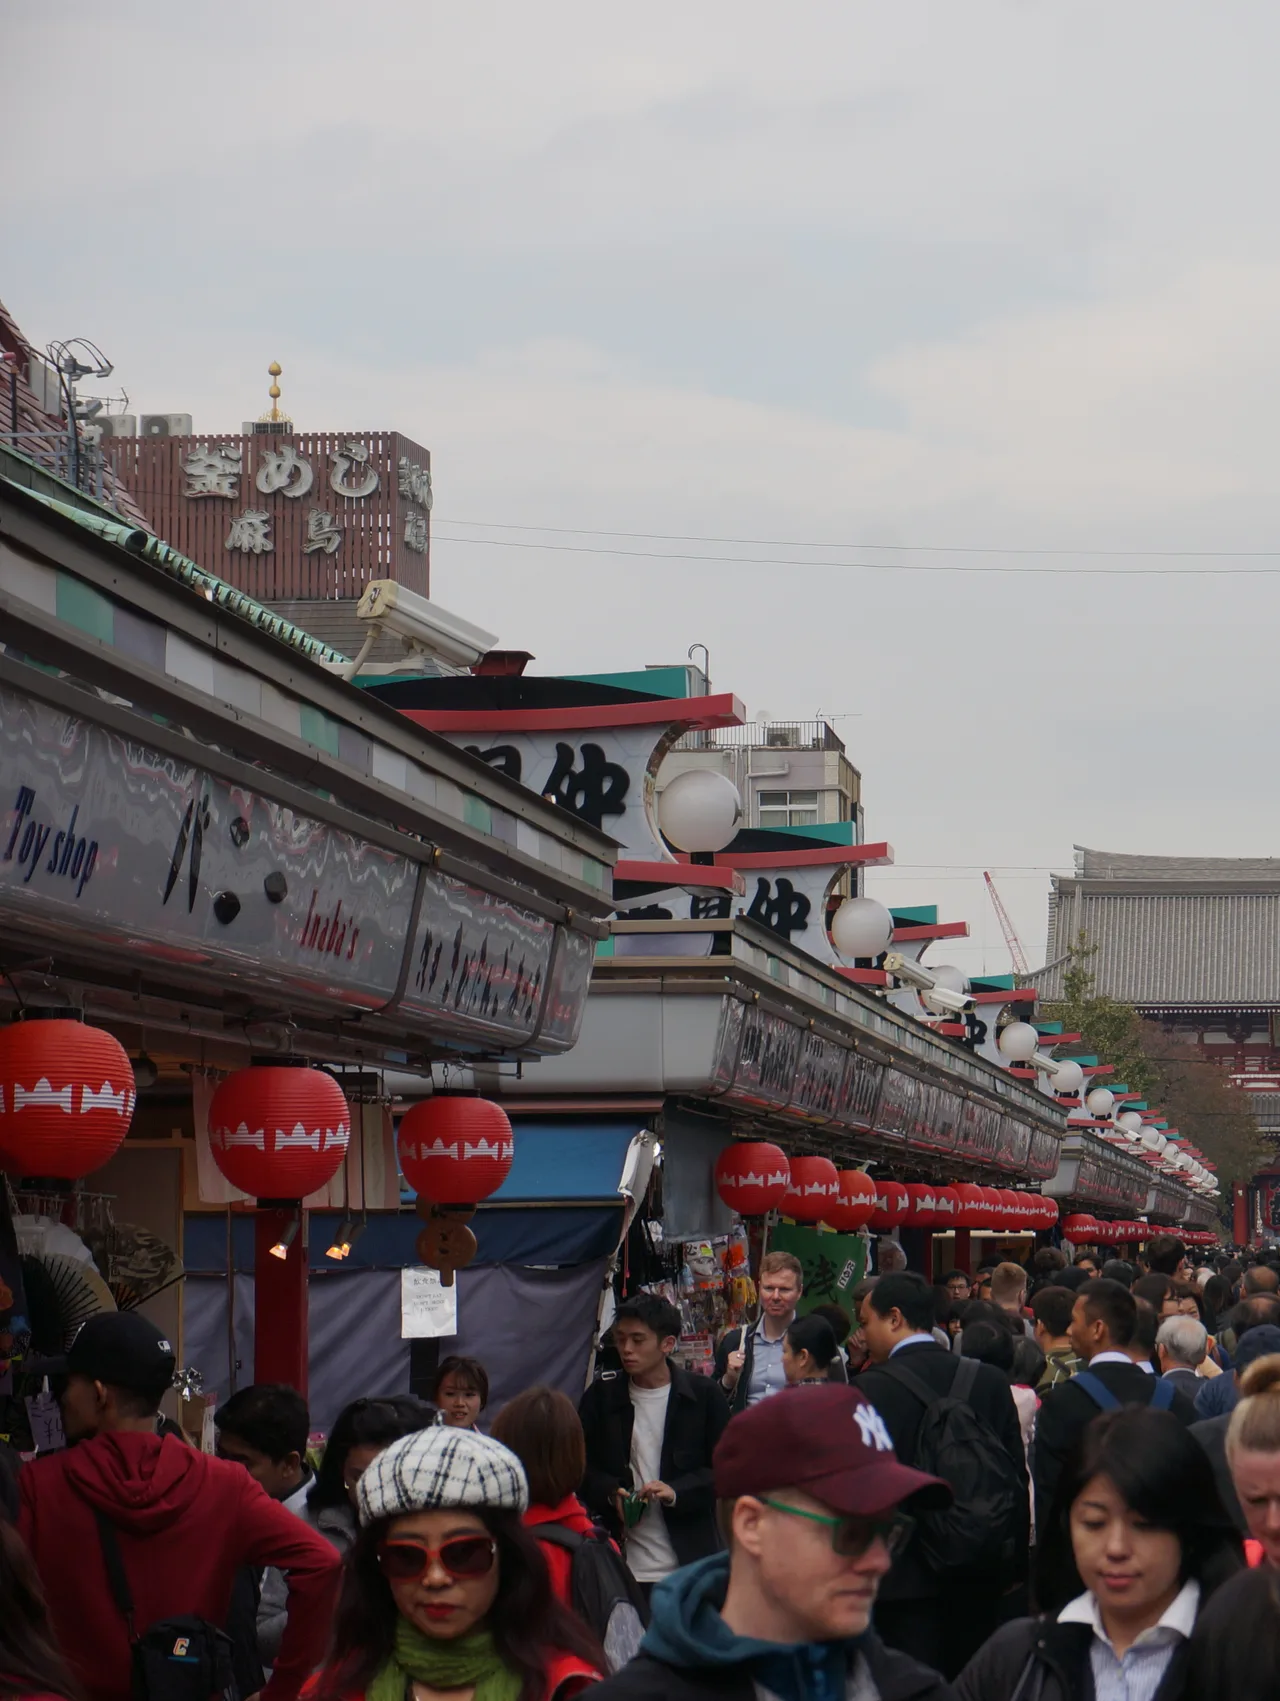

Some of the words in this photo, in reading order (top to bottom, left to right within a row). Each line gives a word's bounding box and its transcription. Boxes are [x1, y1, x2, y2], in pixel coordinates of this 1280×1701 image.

[180, 439, 380, 499] 釜めし
[3, 784, 53, 883] Toy
[46, 805, 99, 898] shop
[302, 888, 360, 961] Inaba's
[413, 1277, 440, 1286] 飲食禁
